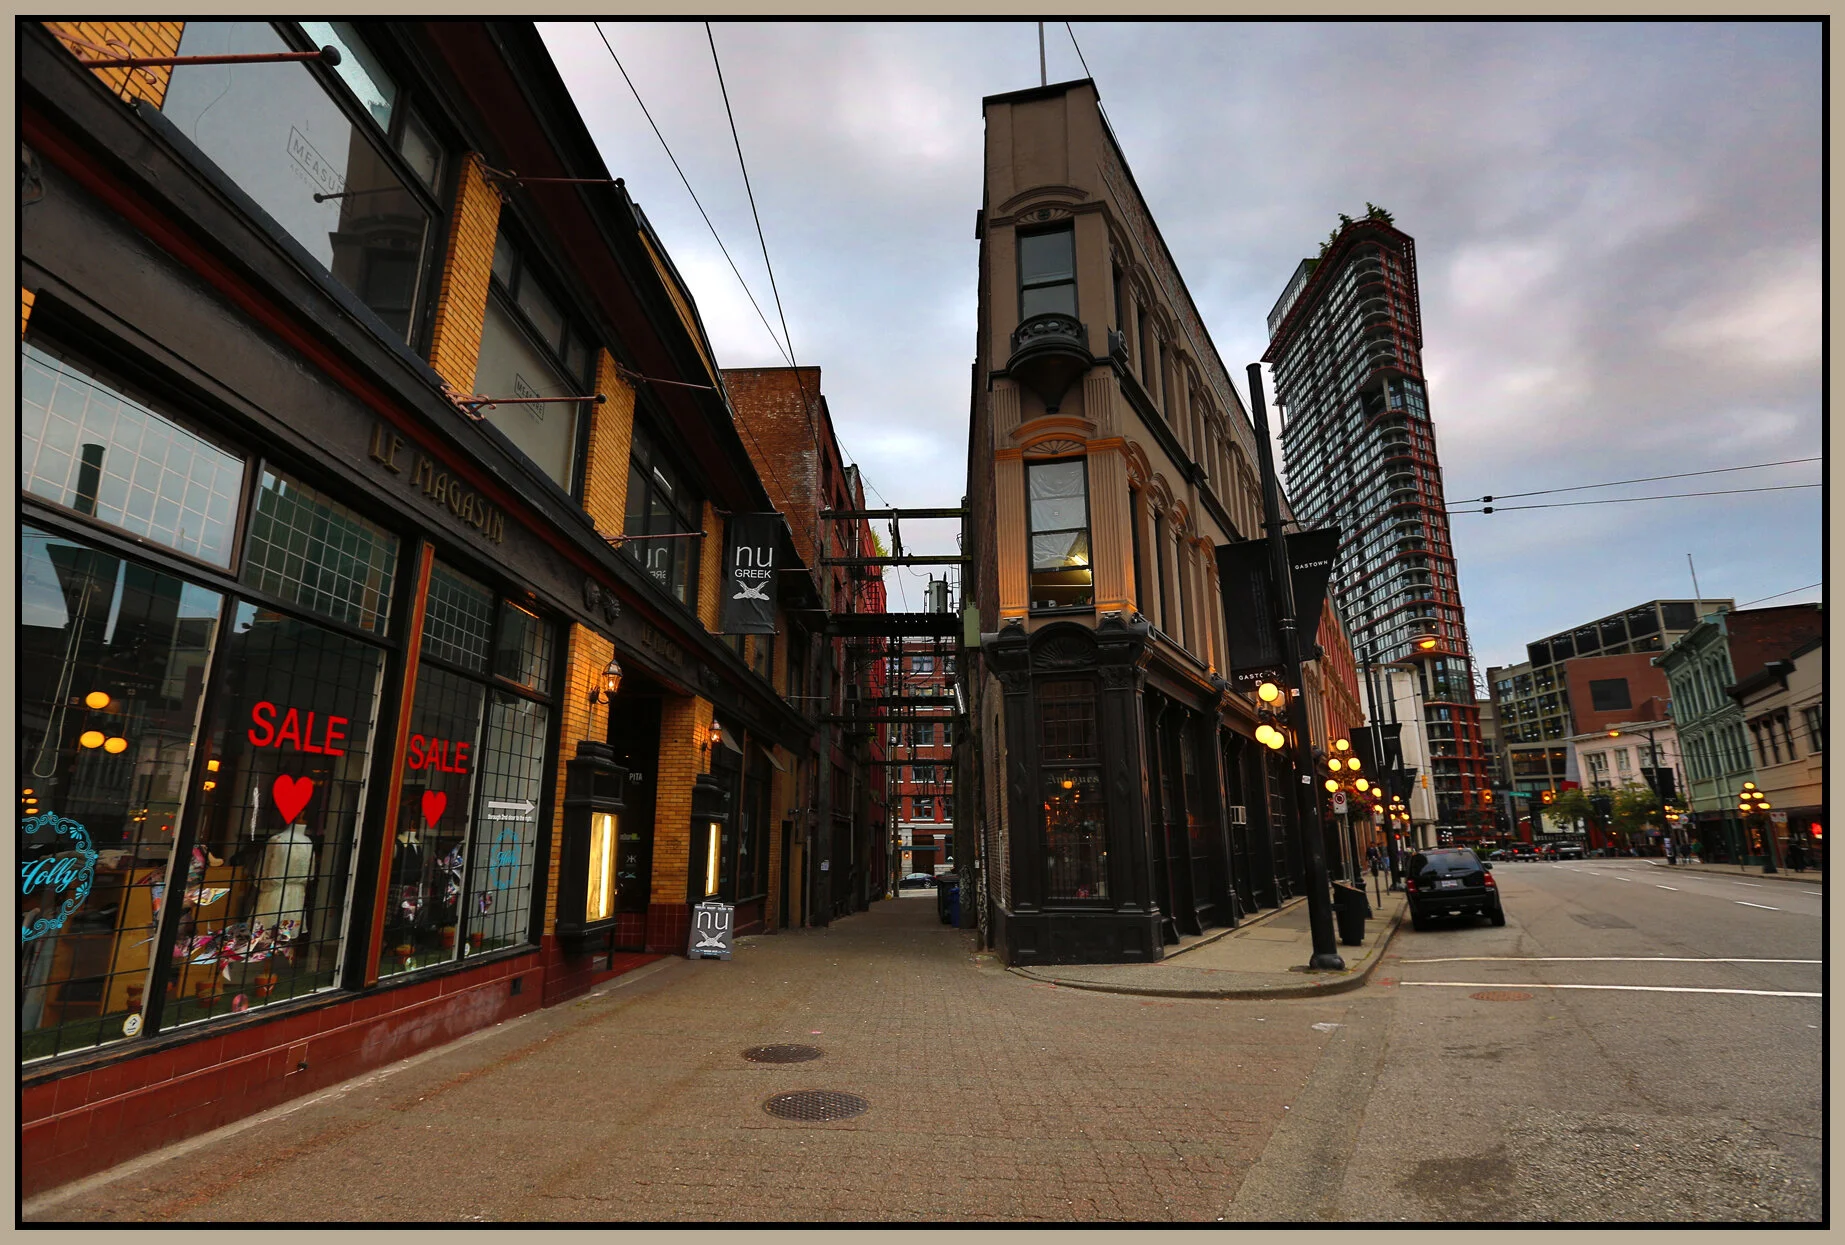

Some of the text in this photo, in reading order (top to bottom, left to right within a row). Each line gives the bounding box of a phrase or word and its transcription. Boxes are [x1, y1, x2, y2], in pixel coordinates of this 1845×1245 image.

[368, 422, 505, 545] LE MAGASIN
[735, 546, 773, 568] nu
[1294, 560, 1329, 571] GASTOWN
[734, 568, 772, 579] GREEK
[248, 701, 349, 757] SALE
[408, 734, 470, 774] SALE
[629, 772, 643, 781] PITA
[21, 857, 79, 894] Holly
[697, 911, 729, 930] nu
